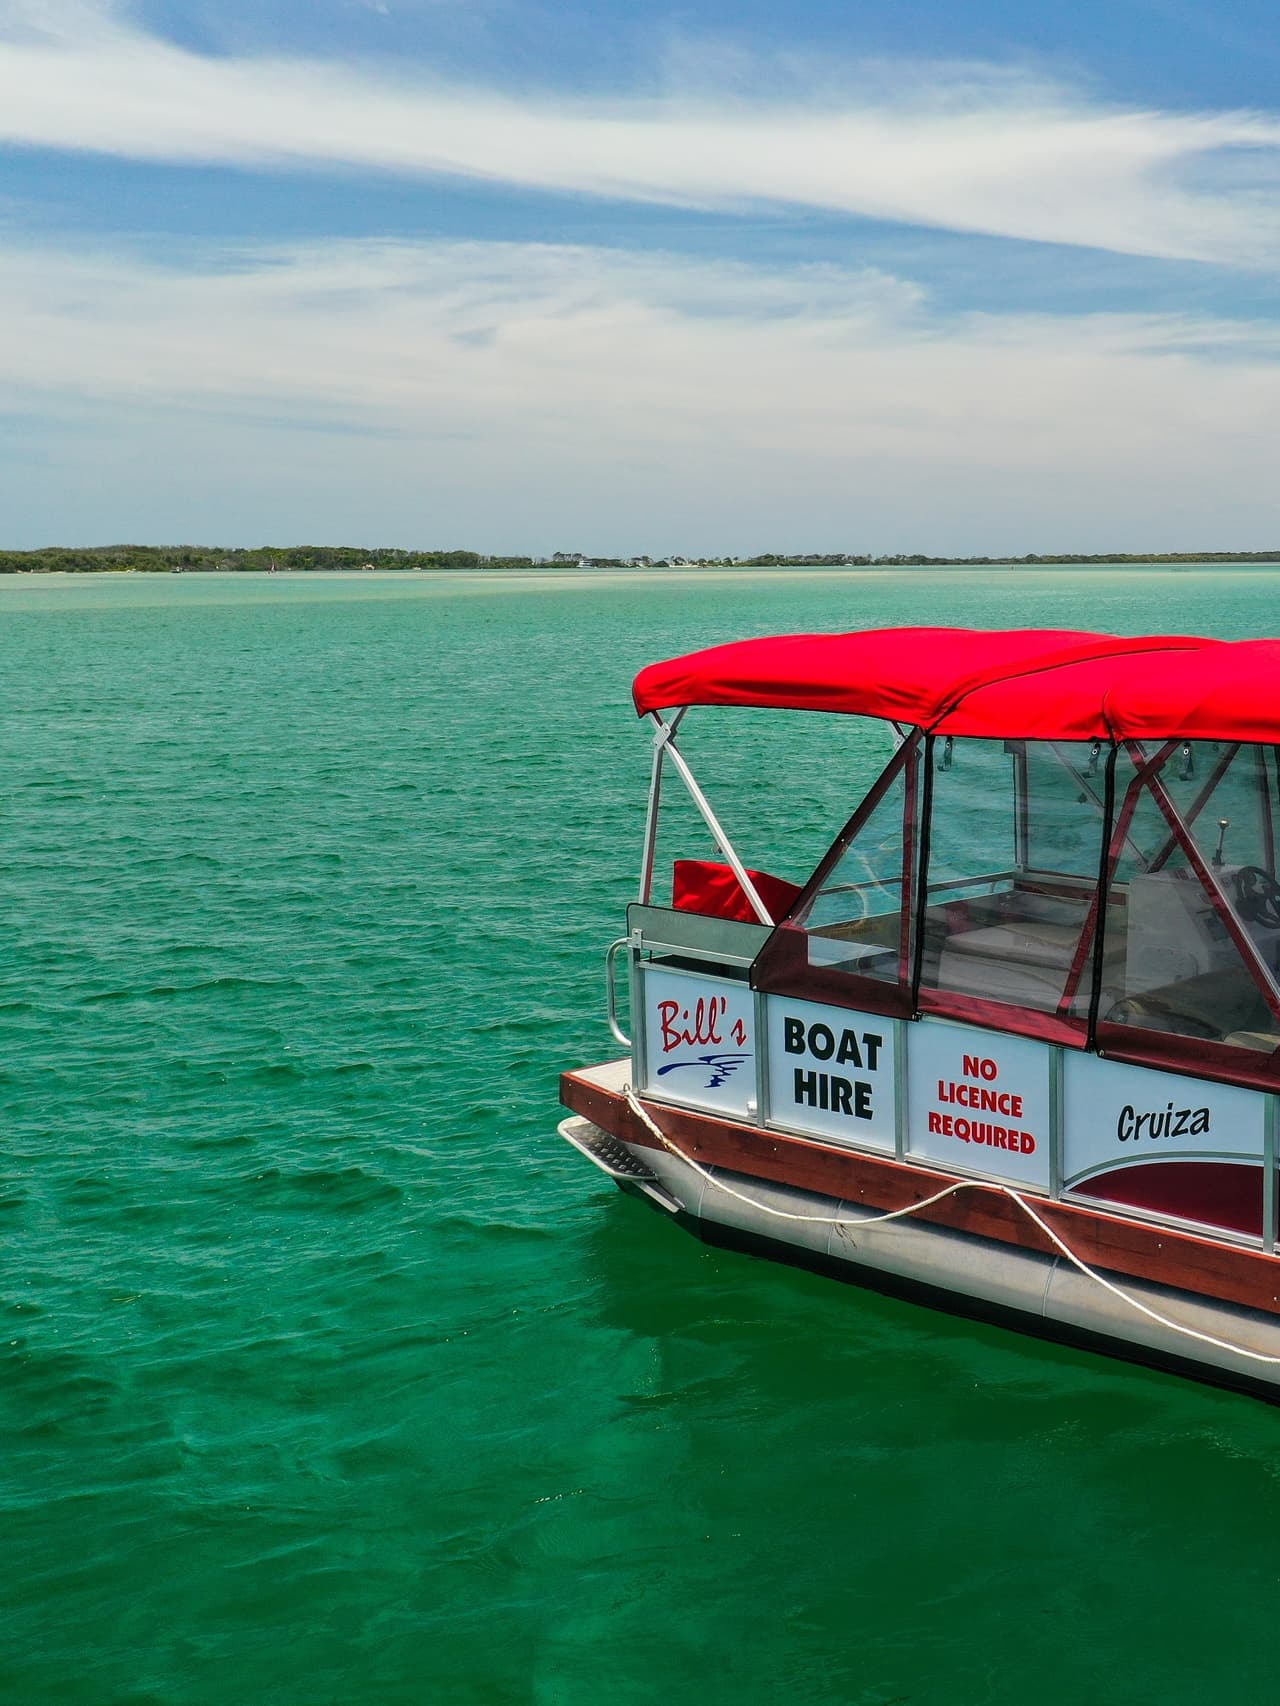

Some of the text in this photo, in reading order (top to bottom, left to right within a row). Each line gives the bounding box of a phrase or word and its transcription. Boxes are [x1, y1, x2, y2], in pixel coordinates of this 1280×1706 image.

[657, 996, 747, 1053] Bill's
[784, 1016, 883, 1071] BOAT
[962, 1054, 998, 1081] NO
[794, 1067, 874, 1120] HIRE
[938, 1079, 1024, 1119] LICENCE
[928, 1111, 1036, 1155] REQUIRED
[1117, 1102, 1210, 1142] Cruiza
